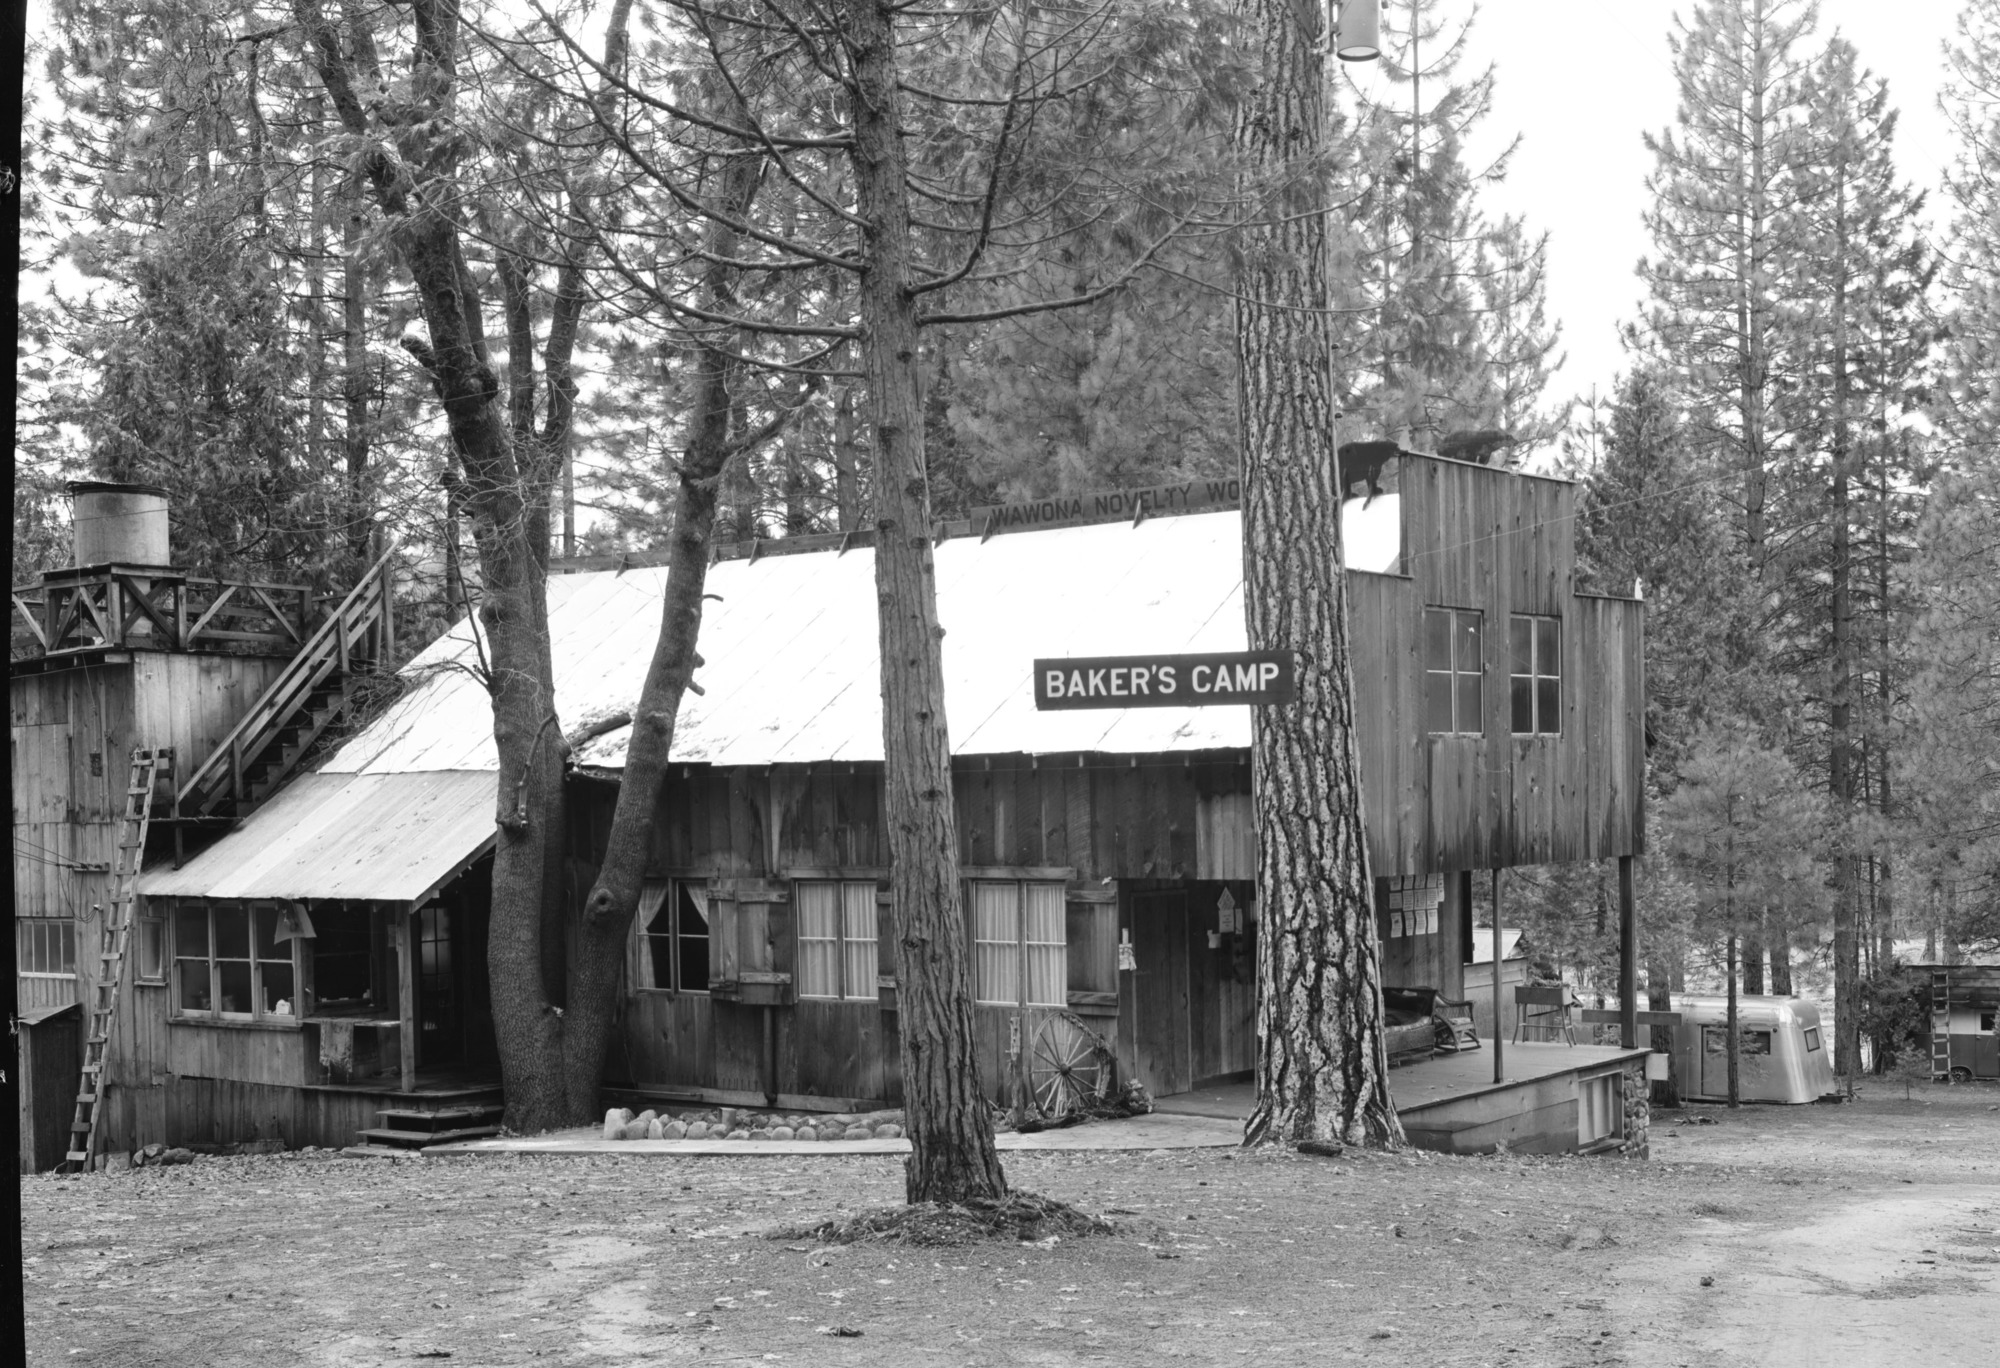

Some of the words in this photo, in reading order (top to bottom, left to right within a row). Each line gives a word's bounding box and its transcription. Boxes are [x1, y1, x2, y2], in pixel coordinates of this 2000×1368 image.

[992, 499, 1081, 526] WAWONA
[1095, 482, 1193, 515] NOVELTY
[1045, 664, 1177, 698] BAKER'S
[1191, 662, 1279, 693] CAMP
